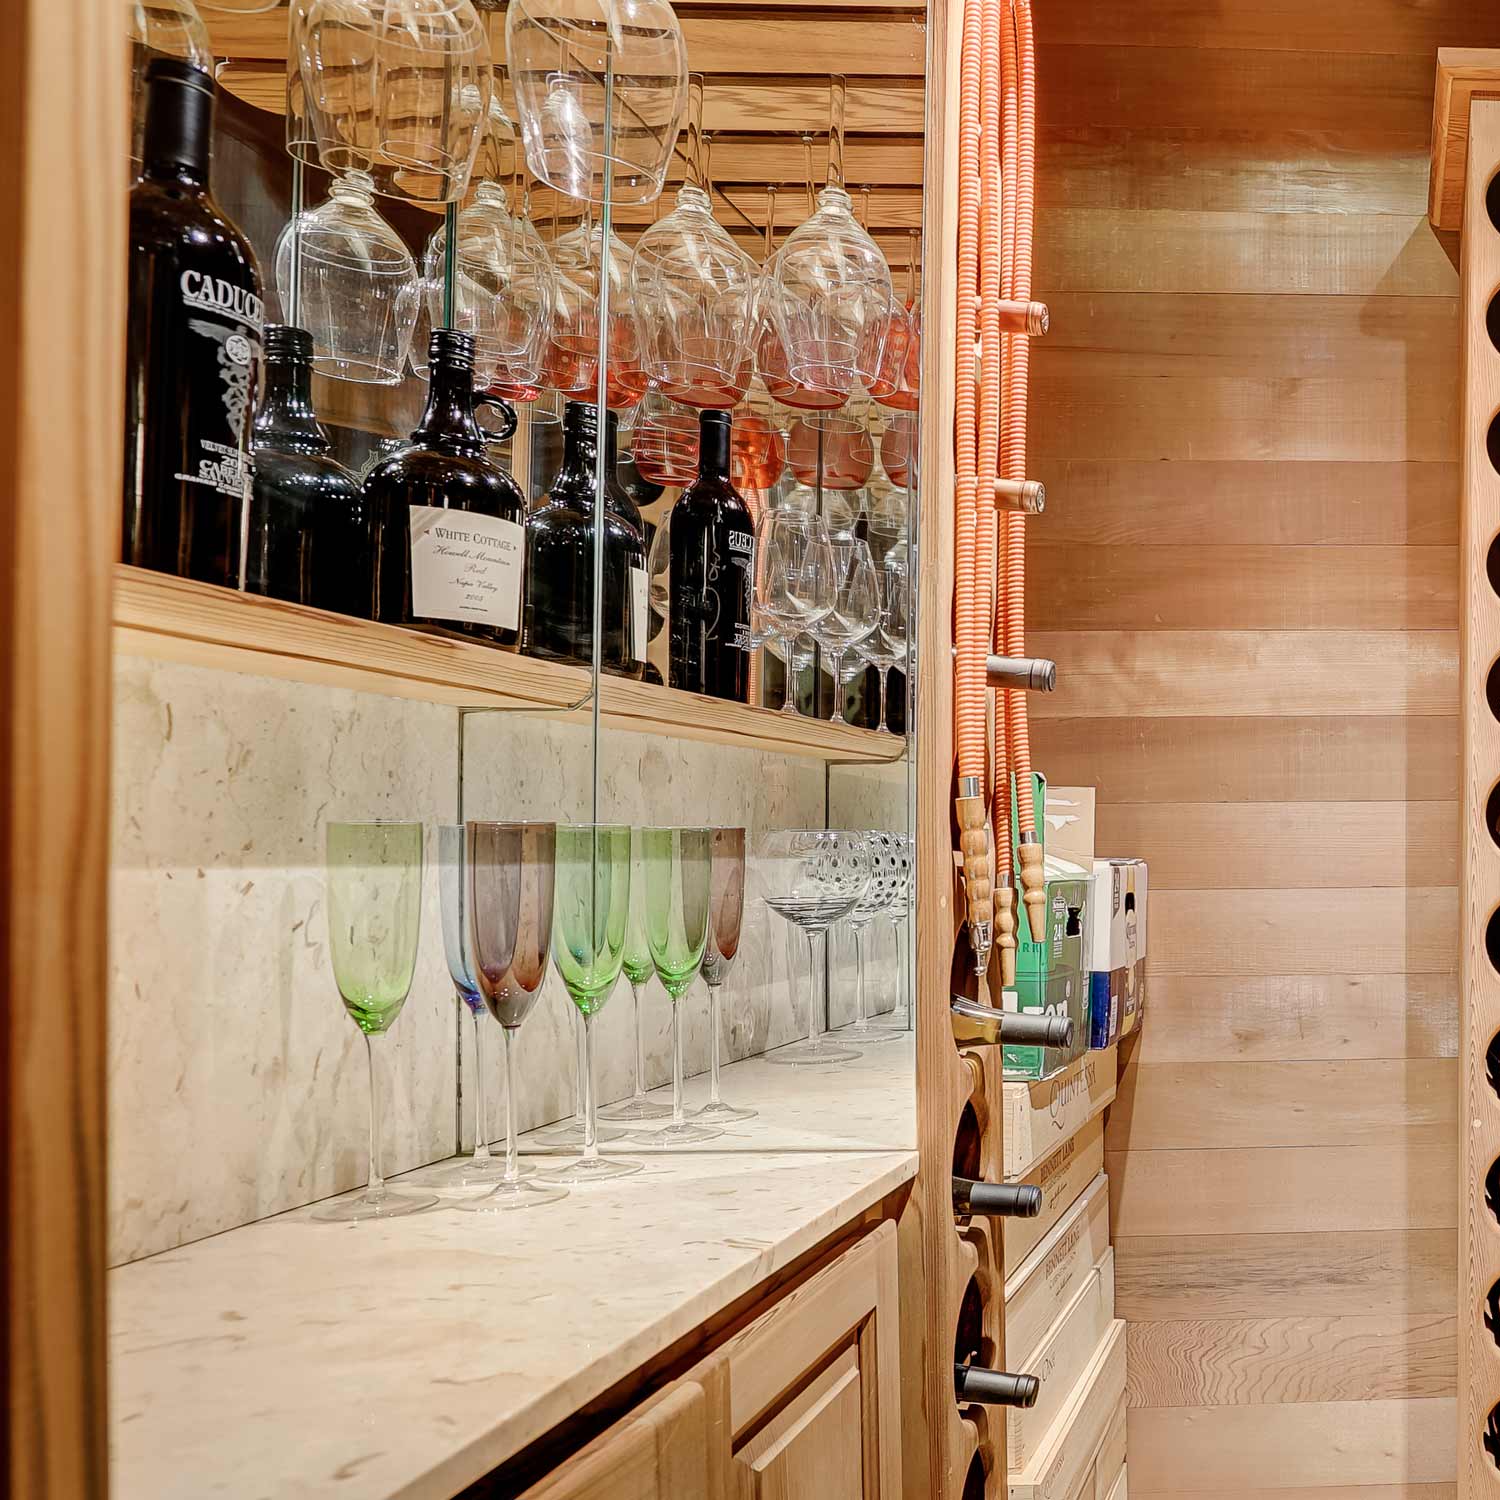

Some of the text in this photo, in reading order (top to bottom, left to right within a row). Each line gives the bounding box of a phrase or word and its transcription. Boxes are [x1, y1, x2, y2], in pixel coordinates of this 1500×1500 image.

[435, 527, 512, 551] WHITE COTTAGE
[1049, 1062, 1097, 1131] QUINTESSA
